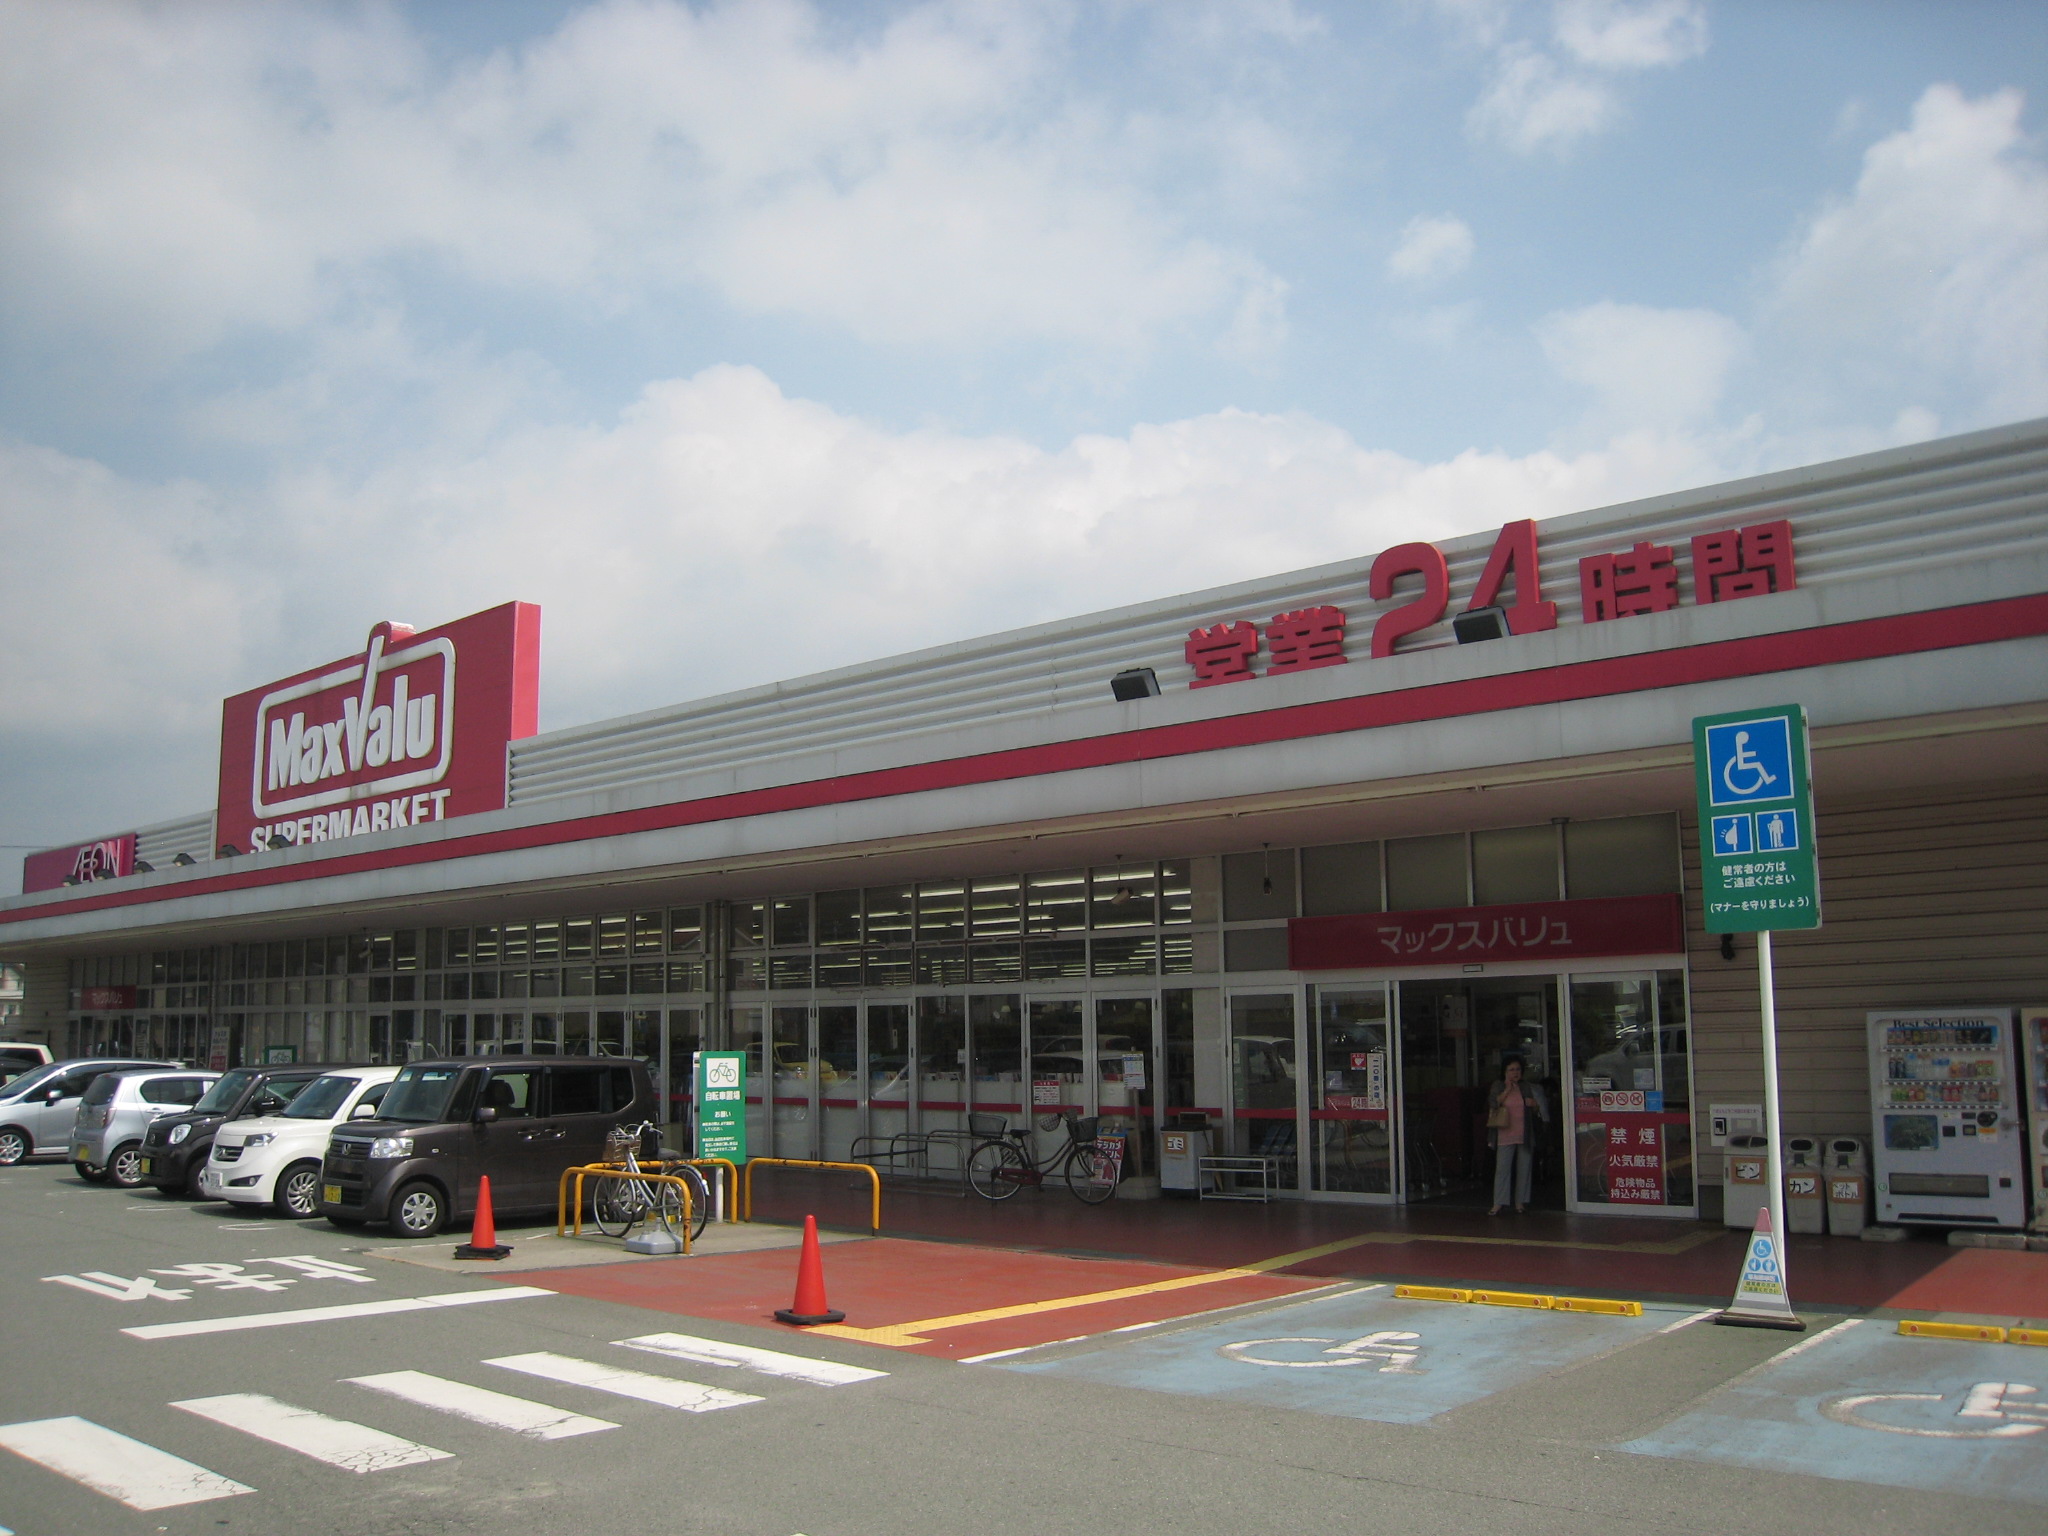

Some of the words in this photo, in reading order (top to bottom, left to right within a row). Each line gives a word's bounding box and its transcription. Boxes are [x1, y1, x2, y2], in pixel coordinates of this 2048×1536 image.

[1185, 518, 1797, 690] 営業24時間
[268, 636, 438, 791] MaxValu
[1722, 861, 1787, 877] 健常者の方は
[1723, 874, 1796, 889] ご遠慮ください
[1710, 896, 1810, 914] (マナーを守りましょう)
[1376, 916, 1573, 955] マックスバリュ
[1609, 1154, 1659, 1168] 火気厳禁
[1736, 1164, 1760, 1179] ビン
[1615, 1177, 1656, 1188] 危険物品
[1790, 1180, 1816, 1194] カン
[40, 1255, 376, 1301] 止まれ
